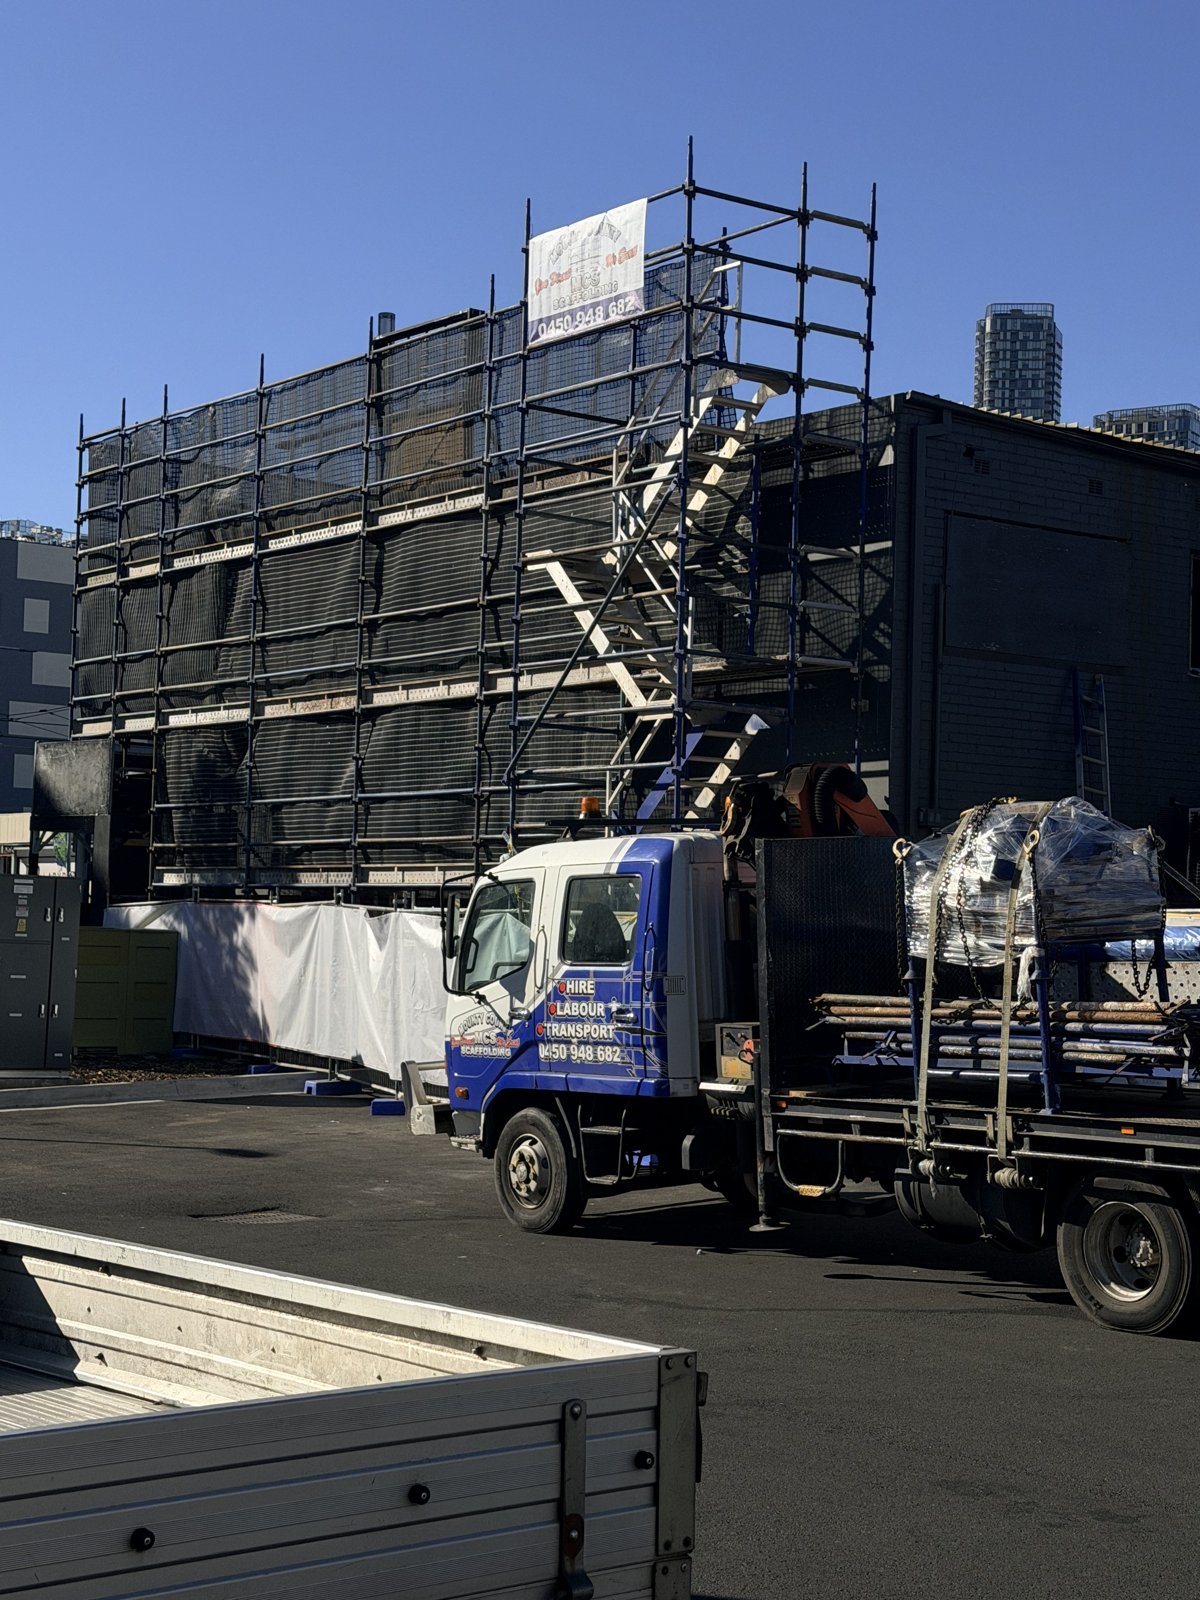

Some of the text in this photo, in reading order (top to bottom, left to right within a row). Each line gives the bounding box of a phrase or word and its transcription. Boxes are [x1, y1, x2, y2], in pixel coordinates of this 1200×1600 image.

[570, 271, 600, 293] MCS
[552, 279, 619, 311] SCAFFOLDING
[538, 296, 635, 338] 0450 948 682
[565, 980, 595, 996] HIRE
[556, 1002, 606, 1018] LABOUR
[458, 1012, 484, 1036] MOUNTY
[544, 1023, 615, 1039] TRANSPORT
[474, 1031, 497, 1046] MCS
[460, 1046, 512, 1058] SCAFFOLDING
[538, 1043, 621, 1063] 0450 948 682
